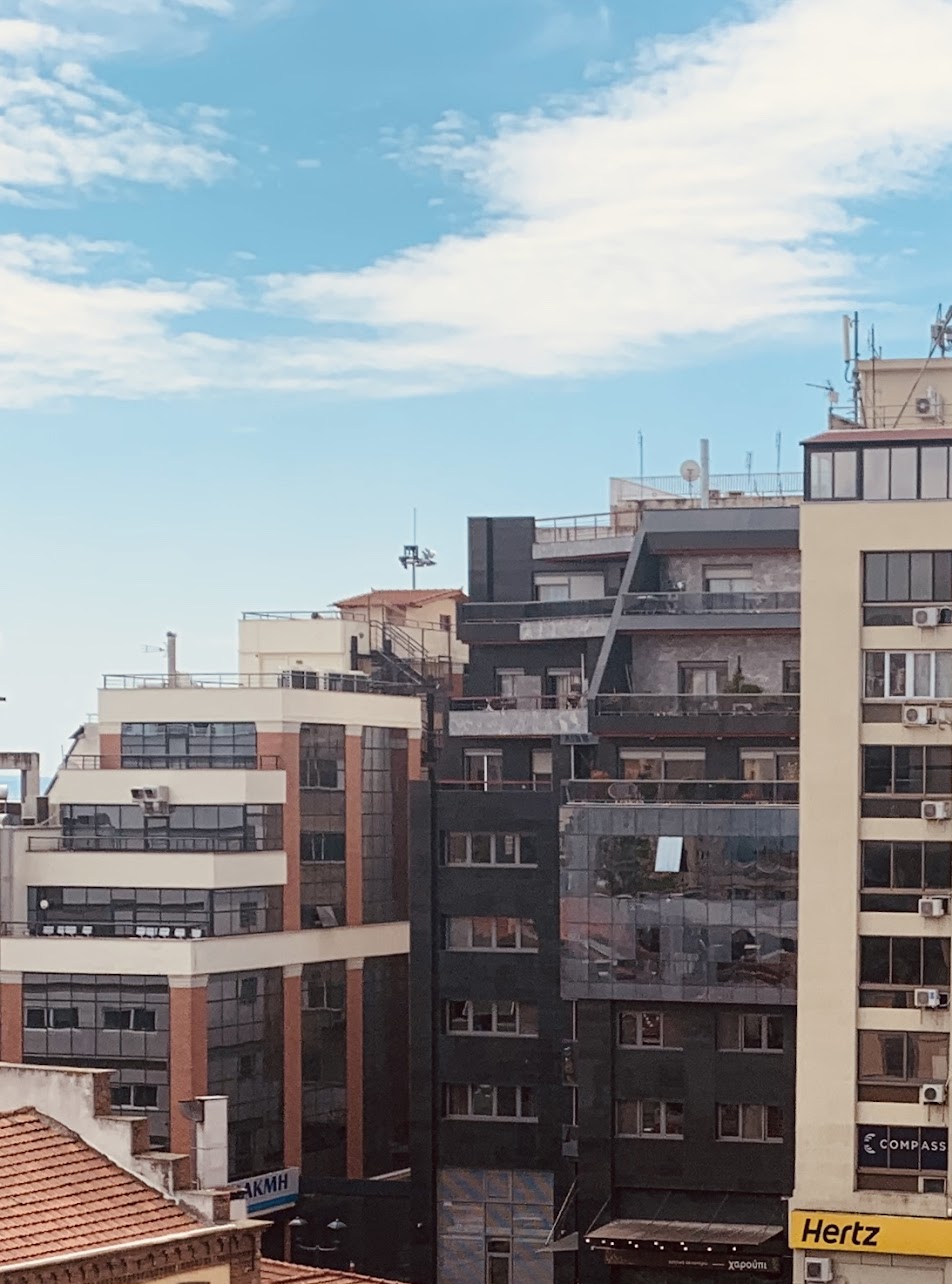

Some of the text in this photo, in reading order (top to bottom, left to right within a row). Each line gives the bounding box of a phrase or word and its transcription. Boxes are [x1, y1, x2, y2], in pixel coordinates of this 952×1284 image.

[879, 1138, 947, 1152] COMPASS
[801, 1218, 880, 1246] Hertz
[728, 1259, 767, 1271] χαρούπι
